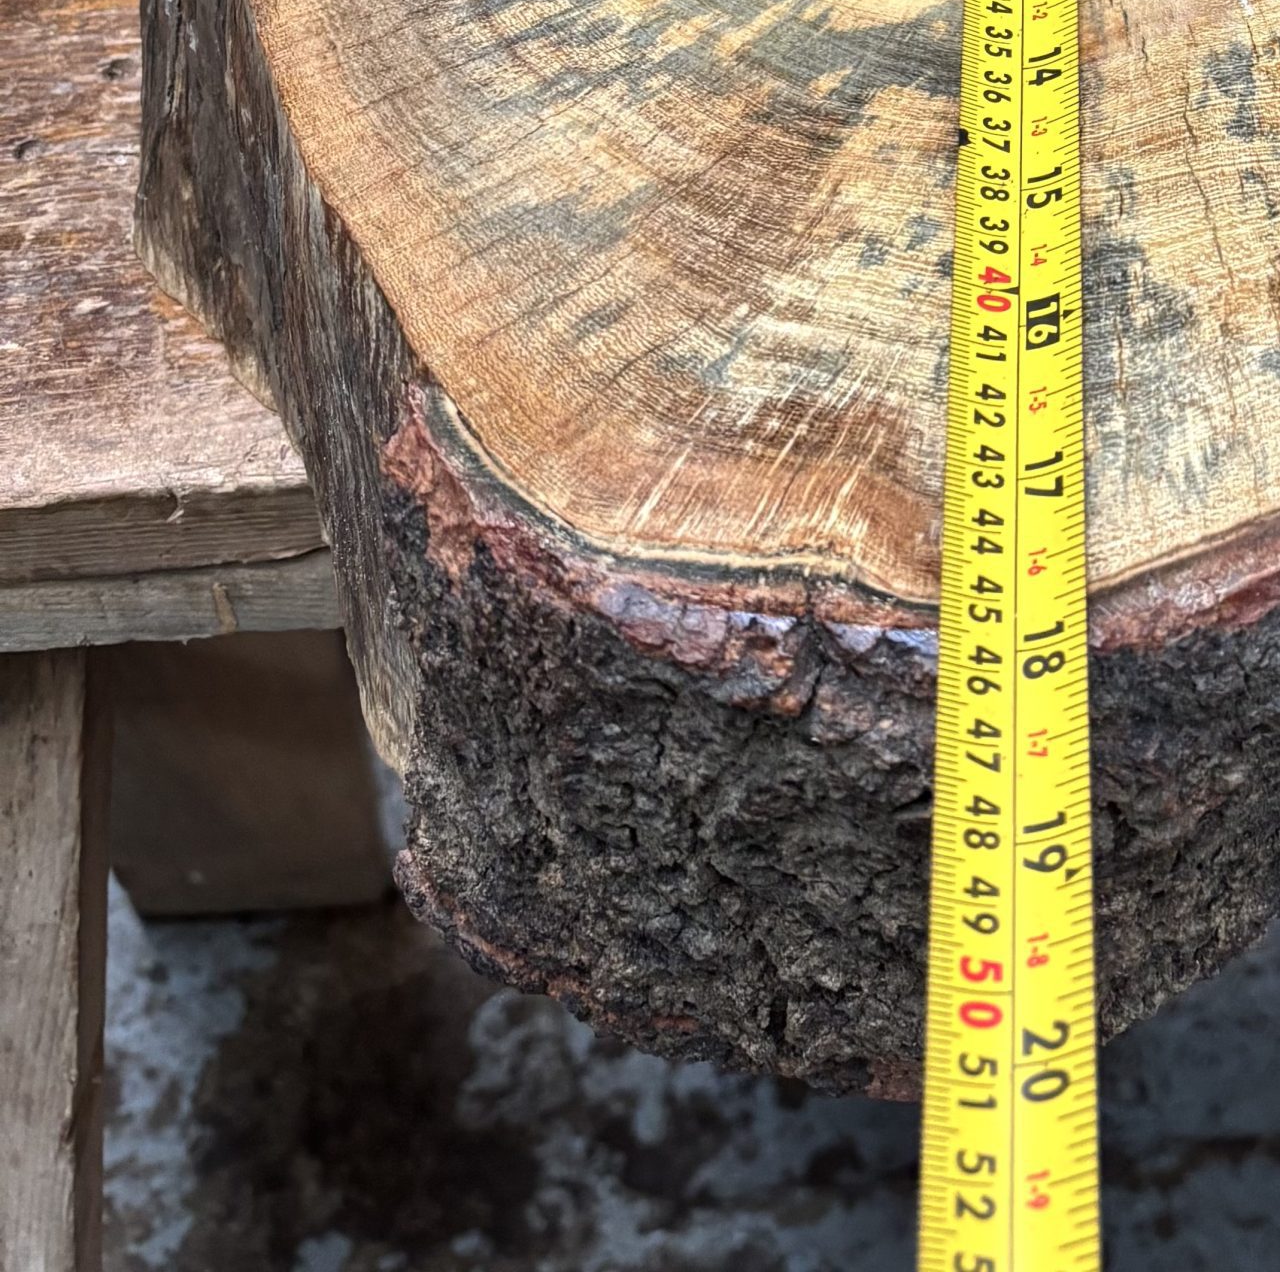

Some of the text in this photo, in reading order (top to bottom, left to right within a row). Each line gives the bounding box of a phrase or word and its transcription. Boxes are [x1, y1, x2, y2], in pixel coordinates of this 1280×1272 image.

[984, 26, 1013, 58] 35
[983, 70, 1012, 103] 36
[1028, 46, 1062, 86] 14
[982, 116, 1011, 153] 37
[980, 165, 1010, 201] 38
[1026, 165, 1063, 209] 15
[979, 216, 1010, 255] 39
[976, 266, 1012, 312] 40
[975, 325, 1007, 361] 41
[1027, 301, 1059, 345] 16
[973, 383, 1006, 428] 42
[972, 444, 1005, 489] 43
[1024, 450, 1064, 497] 17
[970, 508, 1004, 555] 44
[968, 575, 1003, 623] 45
[966, 645, 1002, 695] 46
[1022, 620, 1066, 680] 18
[965, 718, 1002, 773] 47
[963, 795, 1001, 850] 48
[1022, 811, 1068, 873] 19
[962, 875, 1000, 934] 49
[958, 955, 1004, 1030] 50
[957, 1052, 998, 1110] 51
[1021, 1020, 1071, 1103] 20
[955, 1149, 997, 1220] 52
[953, 1251, 996, 1272] 5
